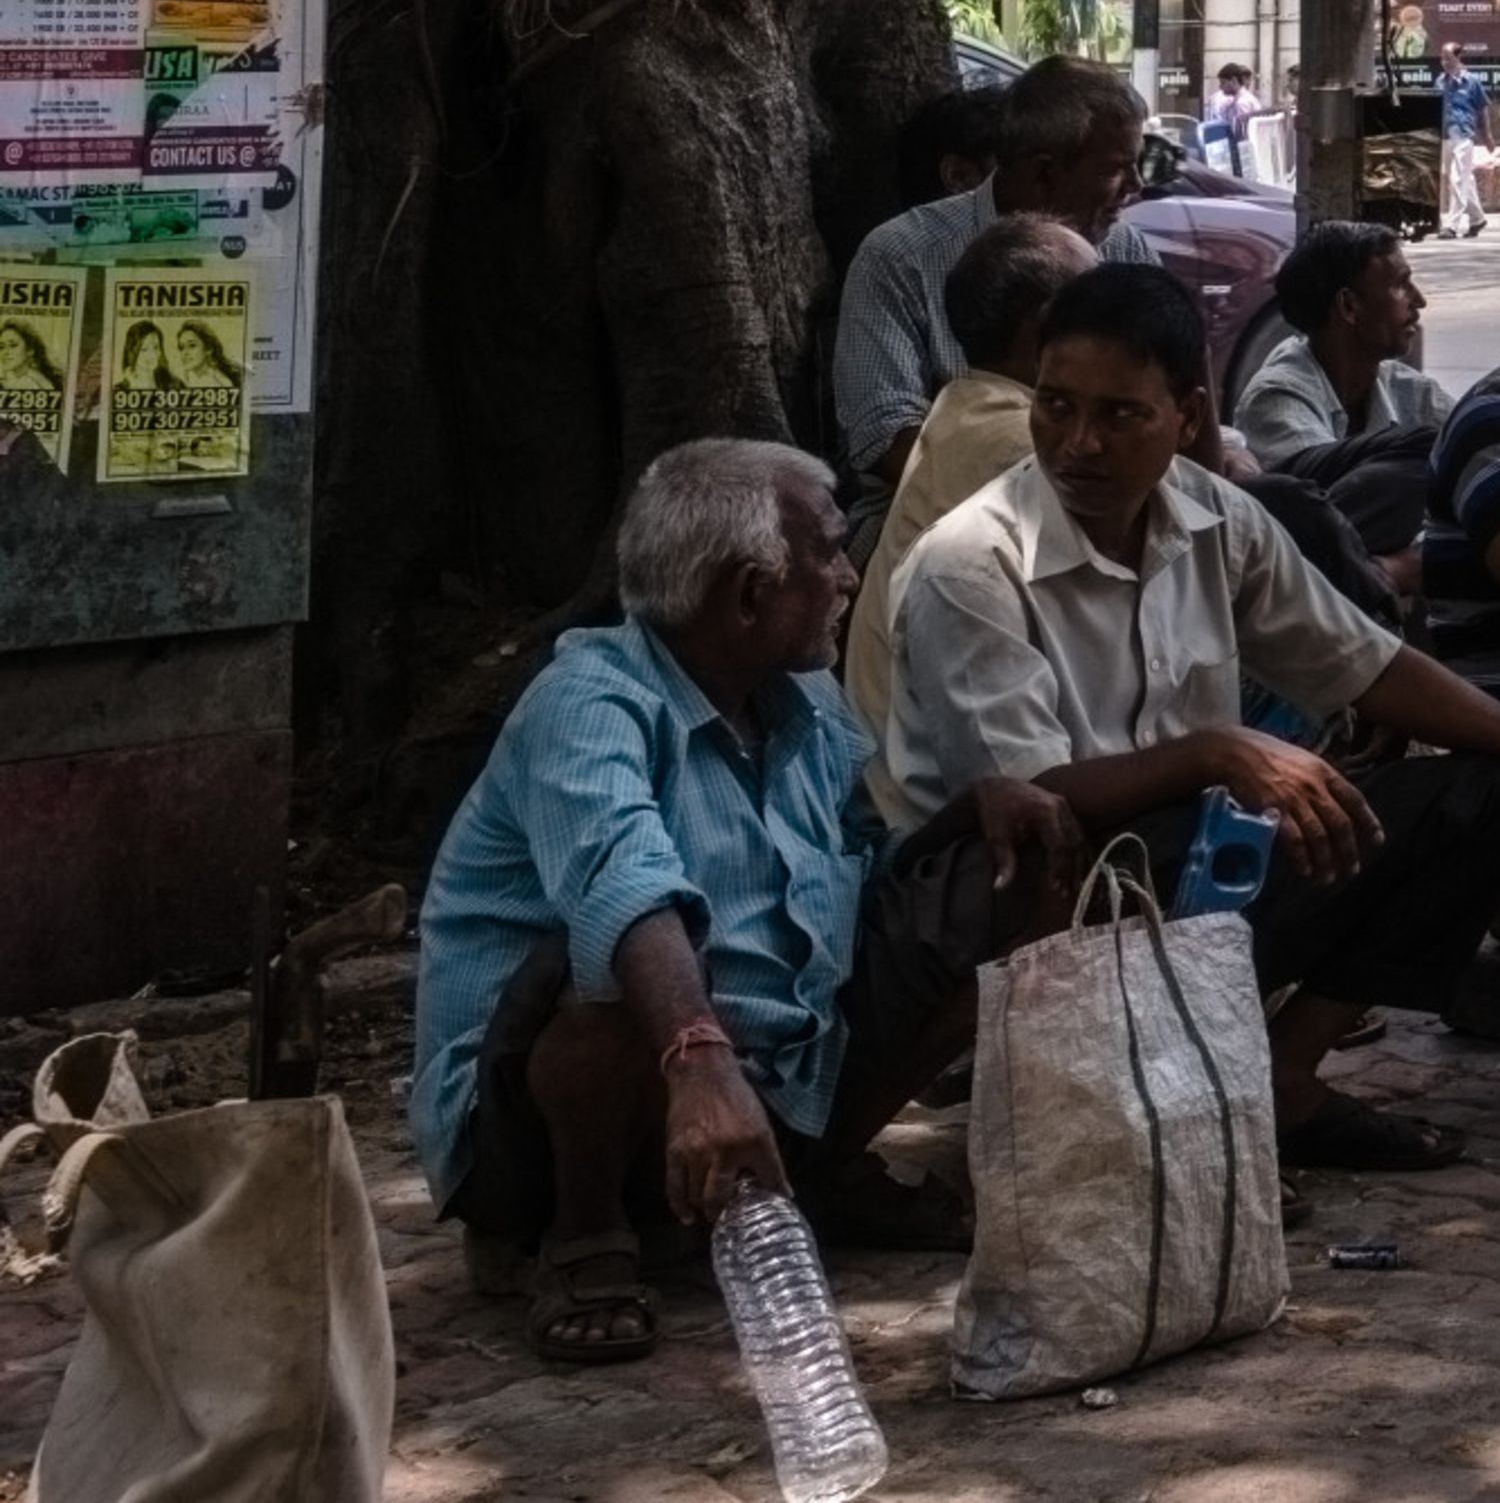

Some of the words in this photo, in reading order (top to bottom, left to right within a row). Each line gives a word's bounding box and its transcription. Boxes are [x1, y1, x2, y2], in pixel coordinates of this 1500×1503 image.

[8, 50, 79, 62] CANDIDATES
[81, 51, 107, 62] GIVE
[149, 146, 214, 168] CONTACT
[216, 145, 237, 165] US
[0, 283, 73, 307] ISHA
[119, 285, 245, 307] TANISHA
[251, 350, 281, 362] REET
[114, 387, 241, 410] 9073072987
[114, 408, 239, 431] 9073072951
